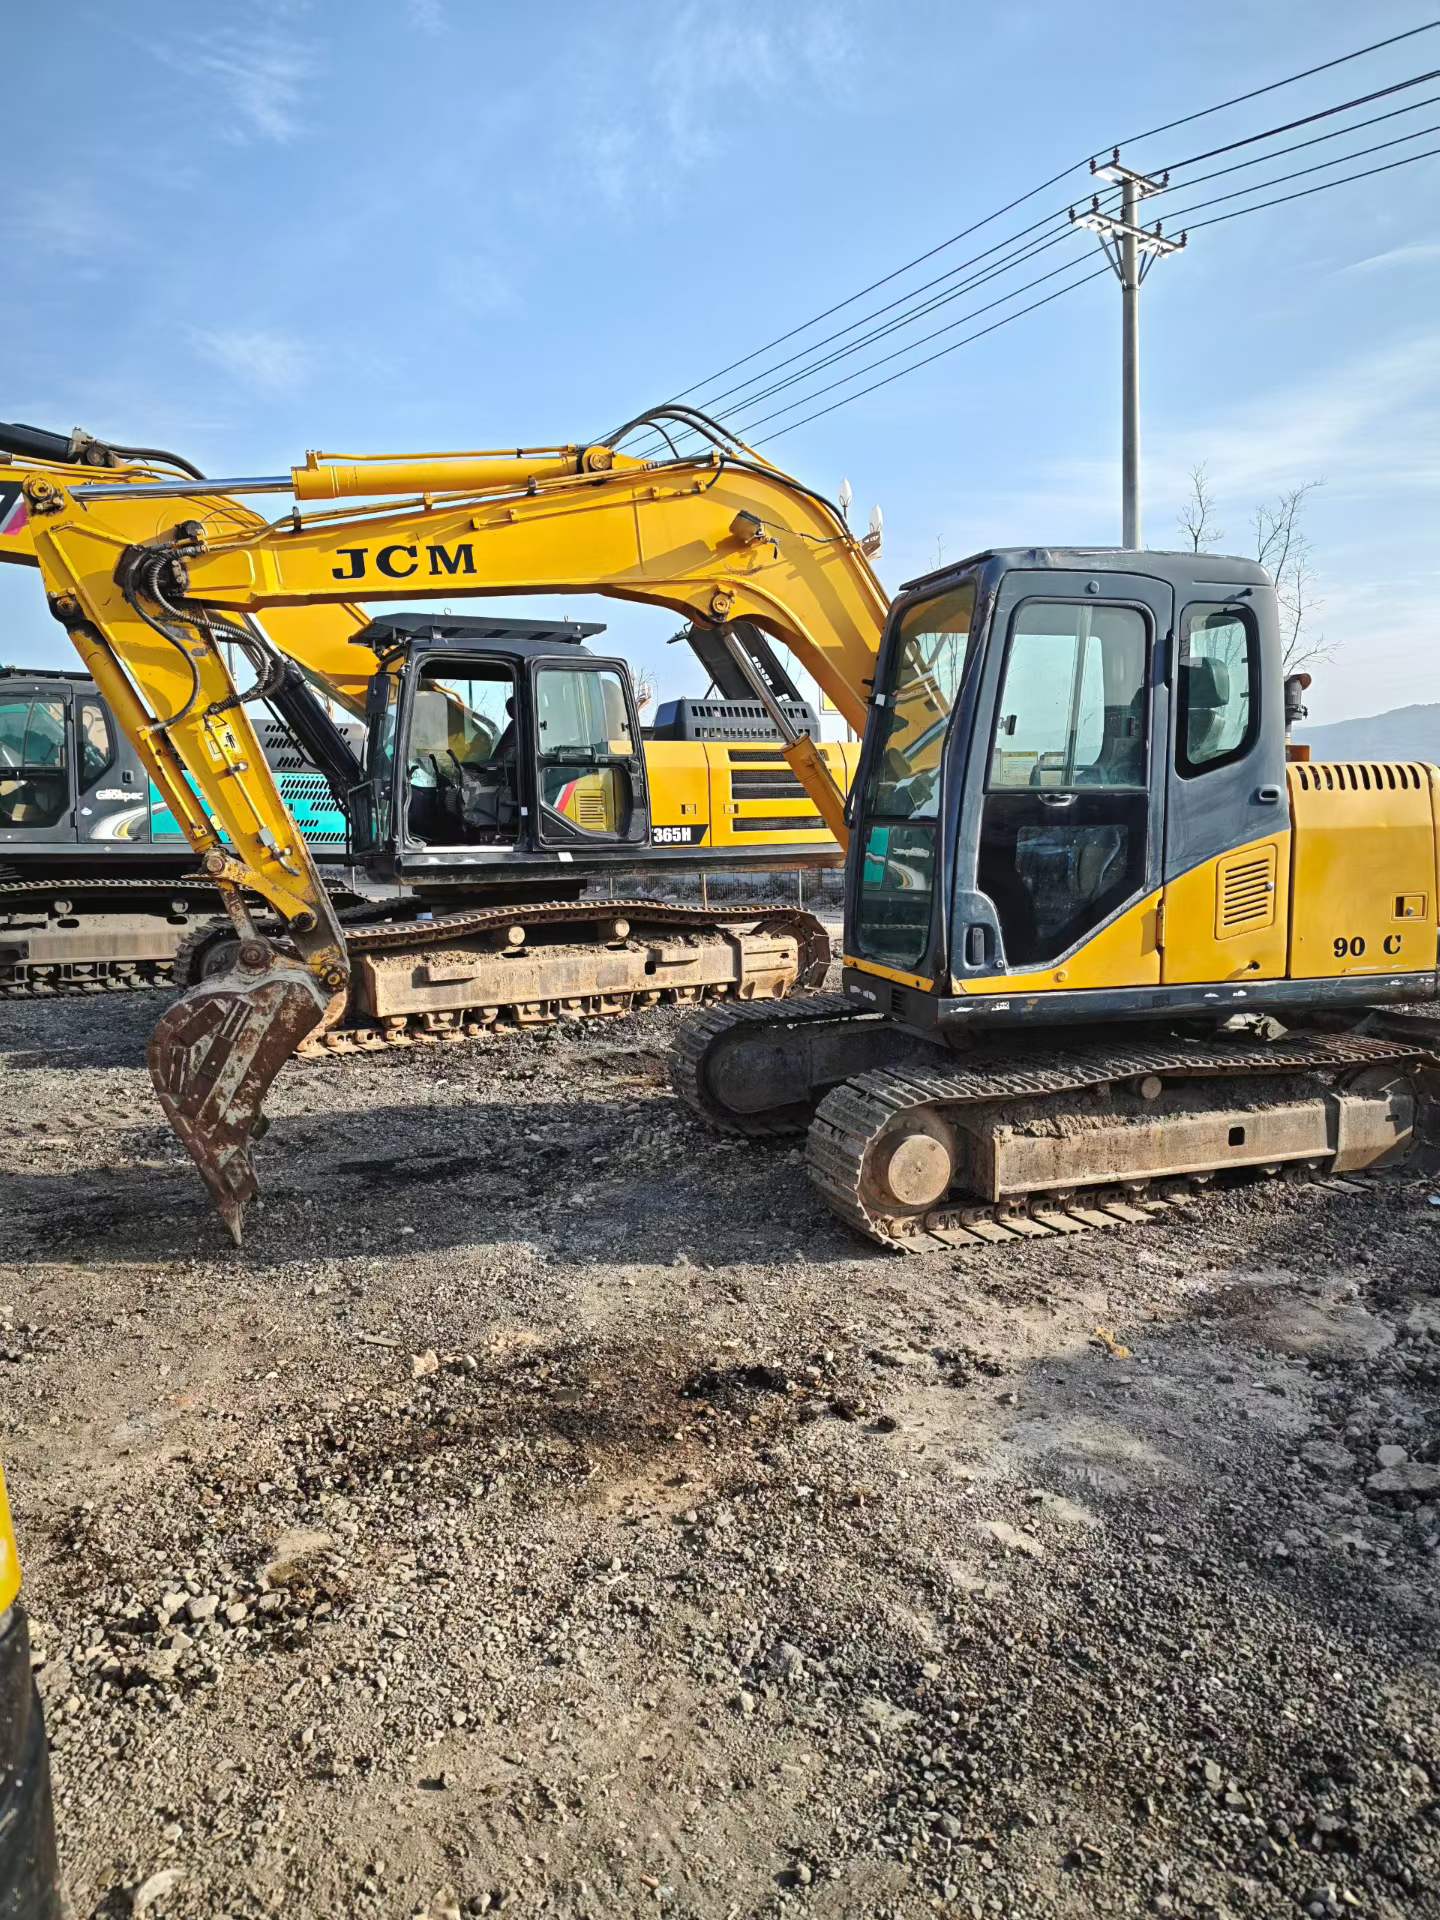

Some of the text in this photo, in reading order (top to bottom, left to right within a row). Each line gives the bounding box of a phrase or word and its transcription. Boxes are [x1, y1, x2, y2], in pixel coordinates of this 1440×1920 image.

[332, 543, 478, 580] JCM
[651, 827, 692, 843] 365H
[1333, 934, 1402, 958] 90 C
